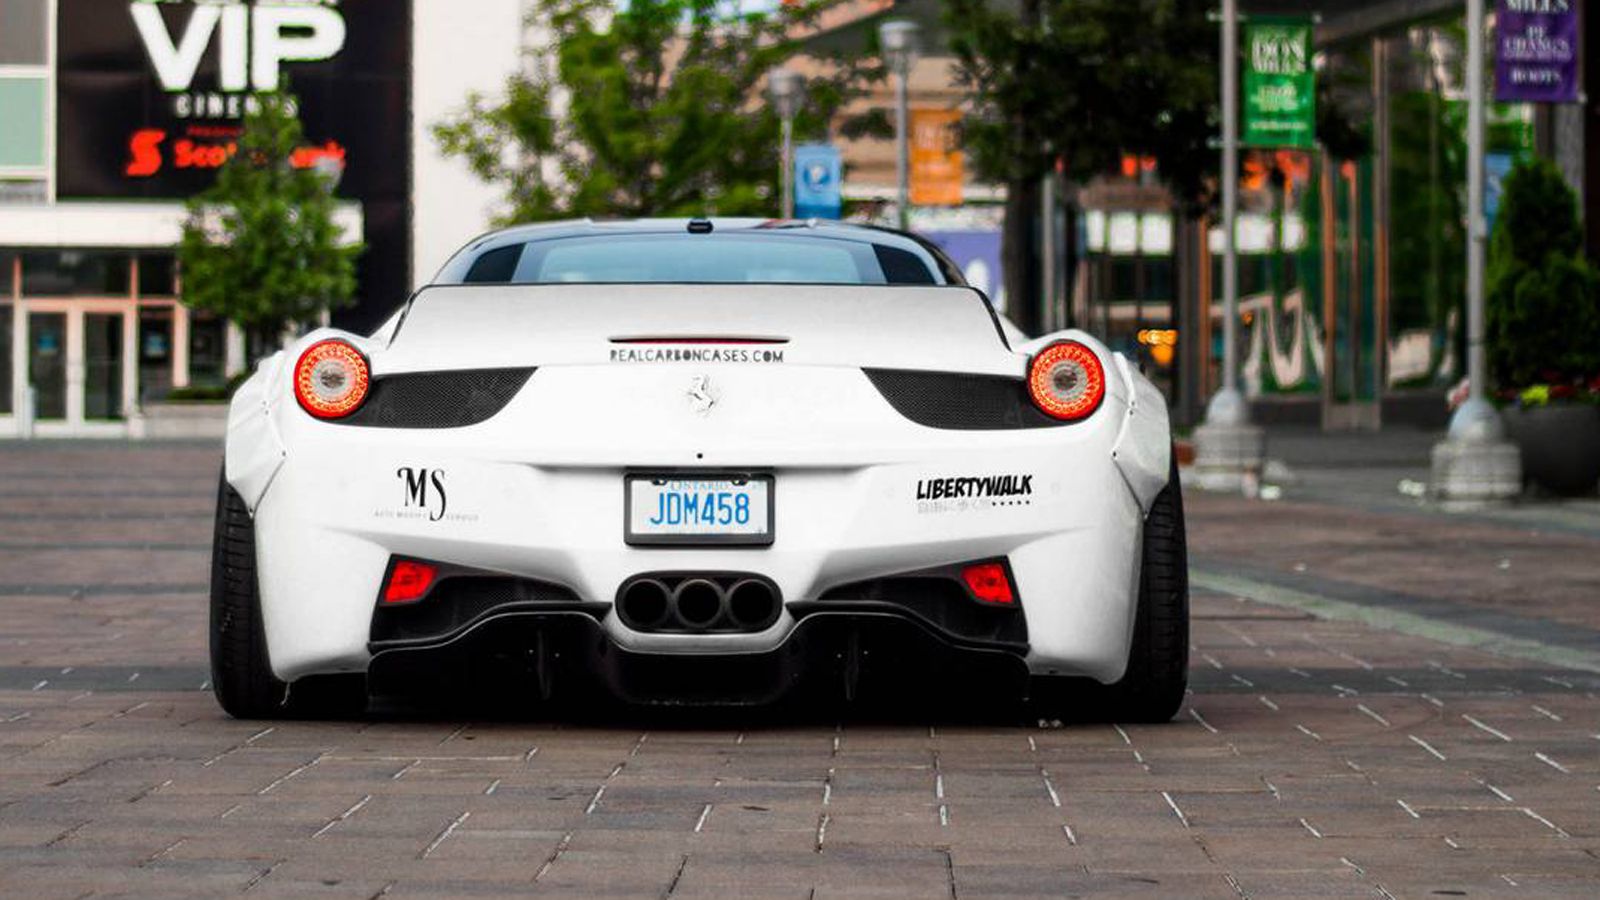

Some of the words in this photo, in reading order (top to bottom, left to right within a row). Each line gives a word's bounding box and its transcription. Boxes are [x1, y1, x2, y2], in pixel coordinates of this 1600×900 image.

[130, 3, 347, 91] VIP
[609, 349, 784, 363] REALCARBONCASES.COM
[397, 467, 447, 521] MS
[916, 475, 1033, 500] LIBERTYWALK
[650, 492, 750, 526] JDM458
